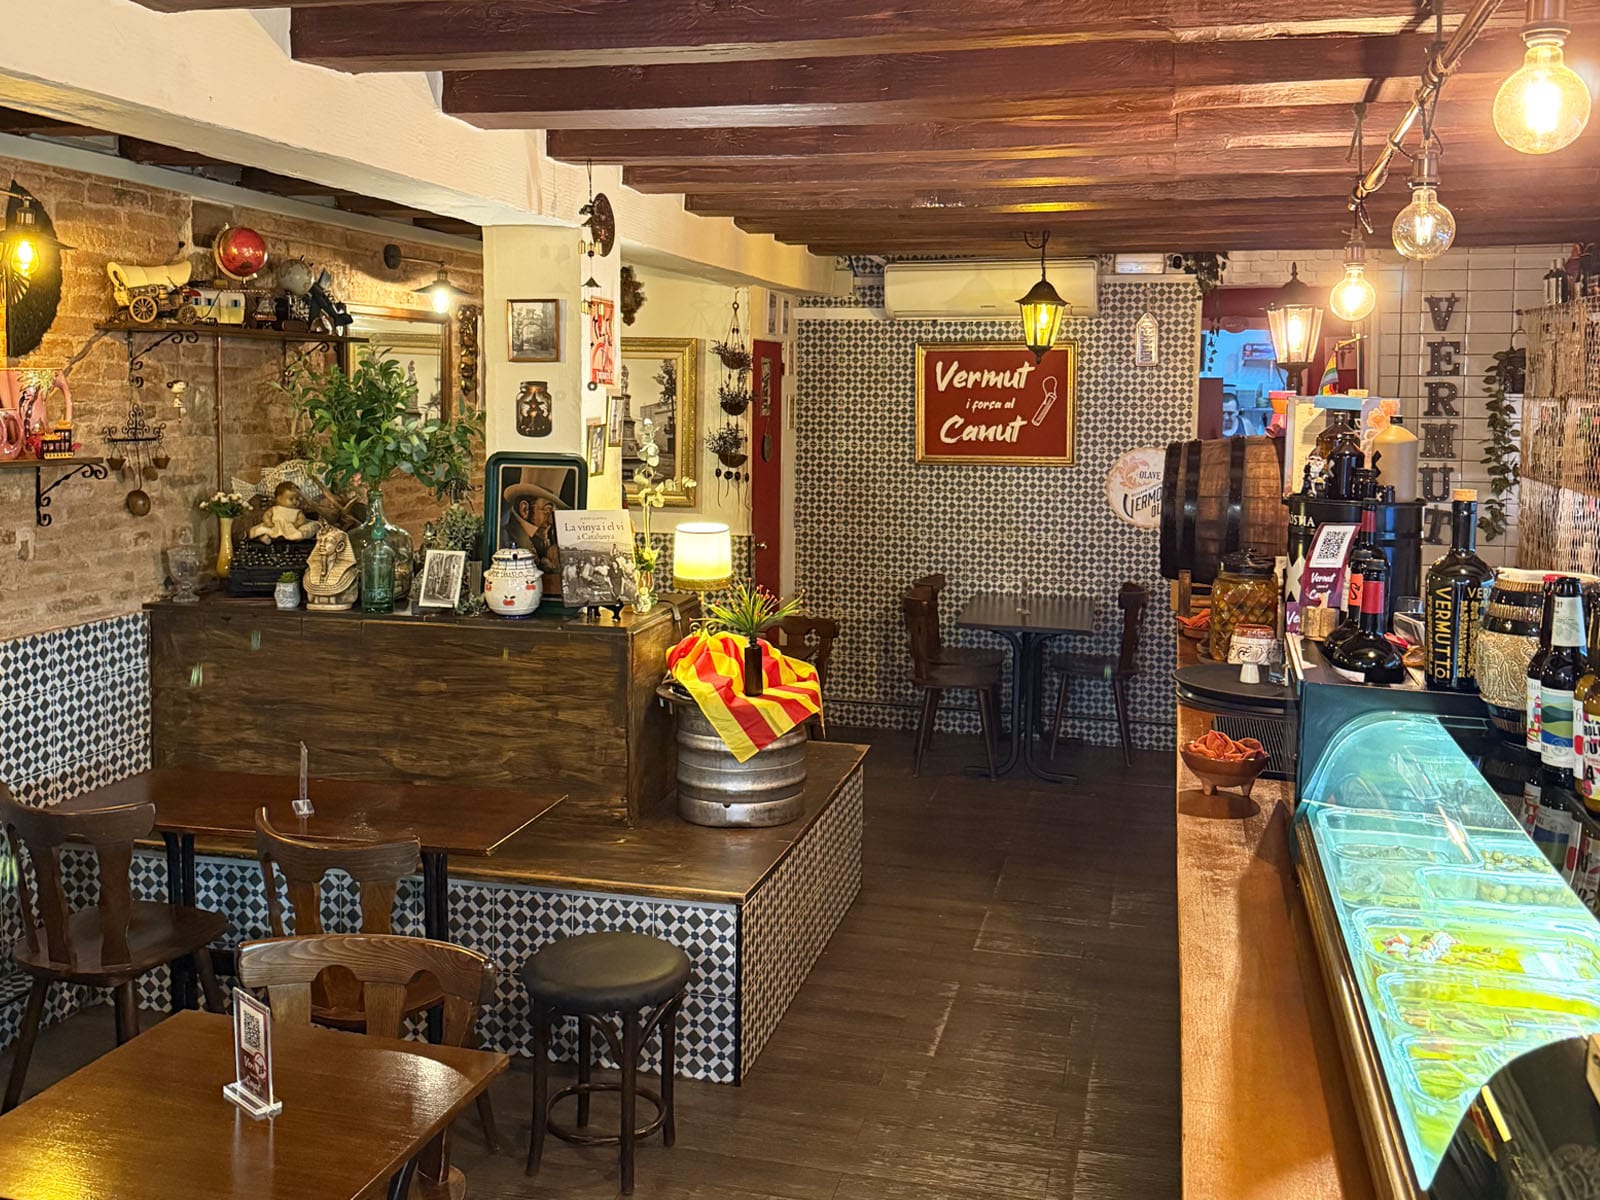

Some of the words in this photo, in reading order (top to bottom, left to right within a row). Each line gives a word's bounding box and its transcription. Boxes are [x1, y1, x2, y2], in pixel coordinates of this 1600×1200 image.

[935, 360, 1036, 392] Vermut
[965, 398, 971, 409] i
[971, 400, 1001, 414] força
[1004, 397, 1016, 409] al
[939, 414, 1028, 444] Canut
[1419, 293, 1460, 546] VERMUT
[564, 522, 576, 532] La
[578, 521, 600, 533] vinya
[602, 521, 606, 531] i
[607, 521, 615, 531] el
[616, 521, 624, 531] vi
[582, 532, 615, 541] Catalunya
